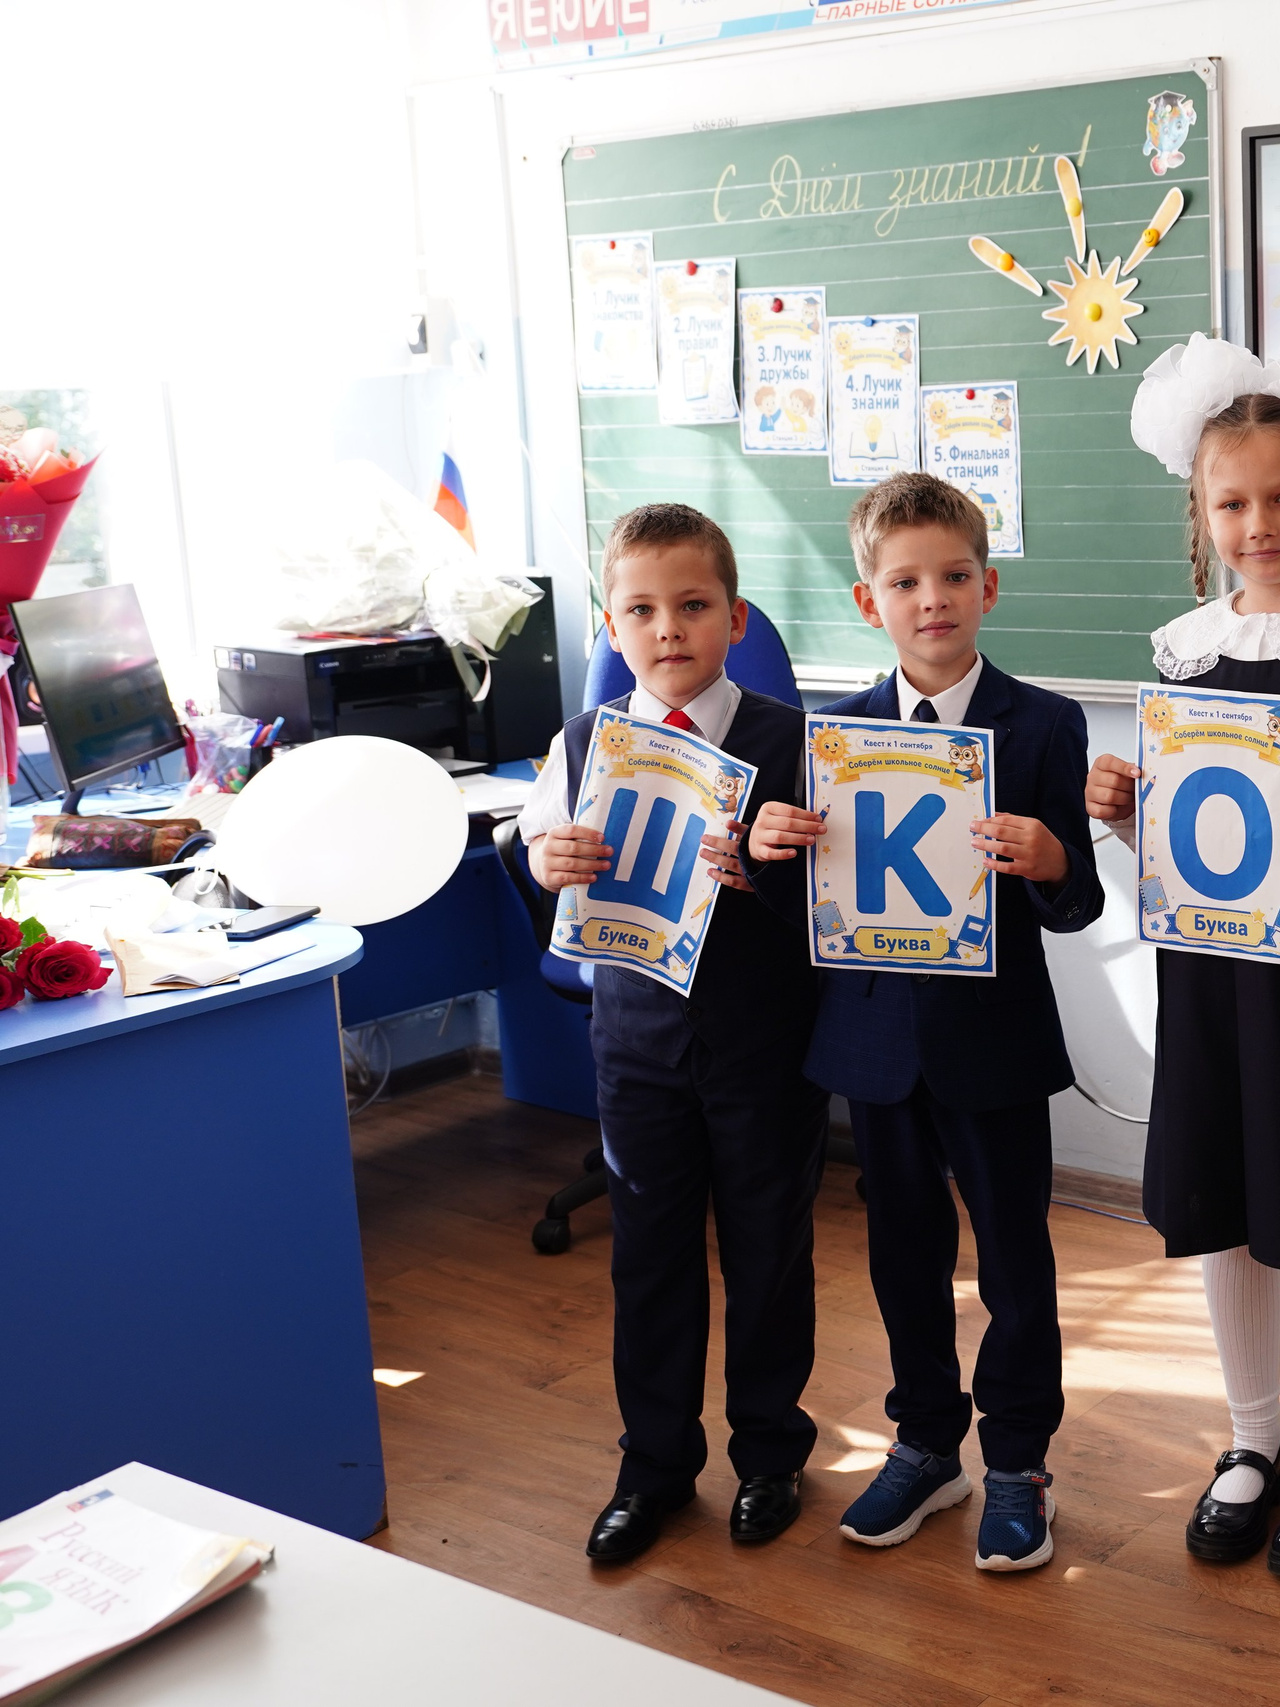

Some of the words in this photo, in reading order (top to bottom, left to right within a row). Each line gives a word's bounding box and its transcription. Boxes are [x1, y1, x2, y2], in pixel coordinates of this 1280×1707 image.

[760, 154, 864, 219] Днём
[874, 143, 1045, 237] знаний
[605, 290, 640, 309] Лучик
[688, 316, 723, 336] Лучик
[678, 336, 719, 354] правил
[757, 346, 770, 362] 3.
[773, 345, 812, 366] Лучик
[759, 365, 810, 385] дружбы
[845, 374, 859, 392] 4.
[863, 374, 902, 396] Лучик
[852, 394, 900, 410] знаний
[934, 446, 947, 462] 5.
[949, 445, 1010, 463] Финальная
[946, 464, 999, 480] станция
[1188, 709, 1208, 719] Квест
[1216, 710, 1220, 719] 1
[1221, 711, 1253, 722] сентября
[864, 739, 885, 748] Квест
[893, 740, 898, 748] 1
[899, 741, 933, 751] сентября
[1173, 729, 1205, 740] Соберём
[1207, 729, 1243, 741] школьное
[1244, 734, 1269, 749] солнце
[649, 740, 669, 751] Квест
[676, 748, 681, 756] 1
[681, 751, 708, 770] сентября
[848, 758, 883, 770] Соберём
[884, 759, 922, 769] школьное
[924, 762, 951, 775] солнце
[628, 757, 661, 769] Соберём
[662, 763, 694, 785] школьное
[694, 779, 713, 798] солнце
[1169, 766, 1273, 901] О
[587, 788, 707, 925] Ш
[855, 790, 953, 917] К
[1194, 914, 1249, 937] Буква
[597, 925, 650, 951] Буква
[873, 934, 931, 954] Буква
